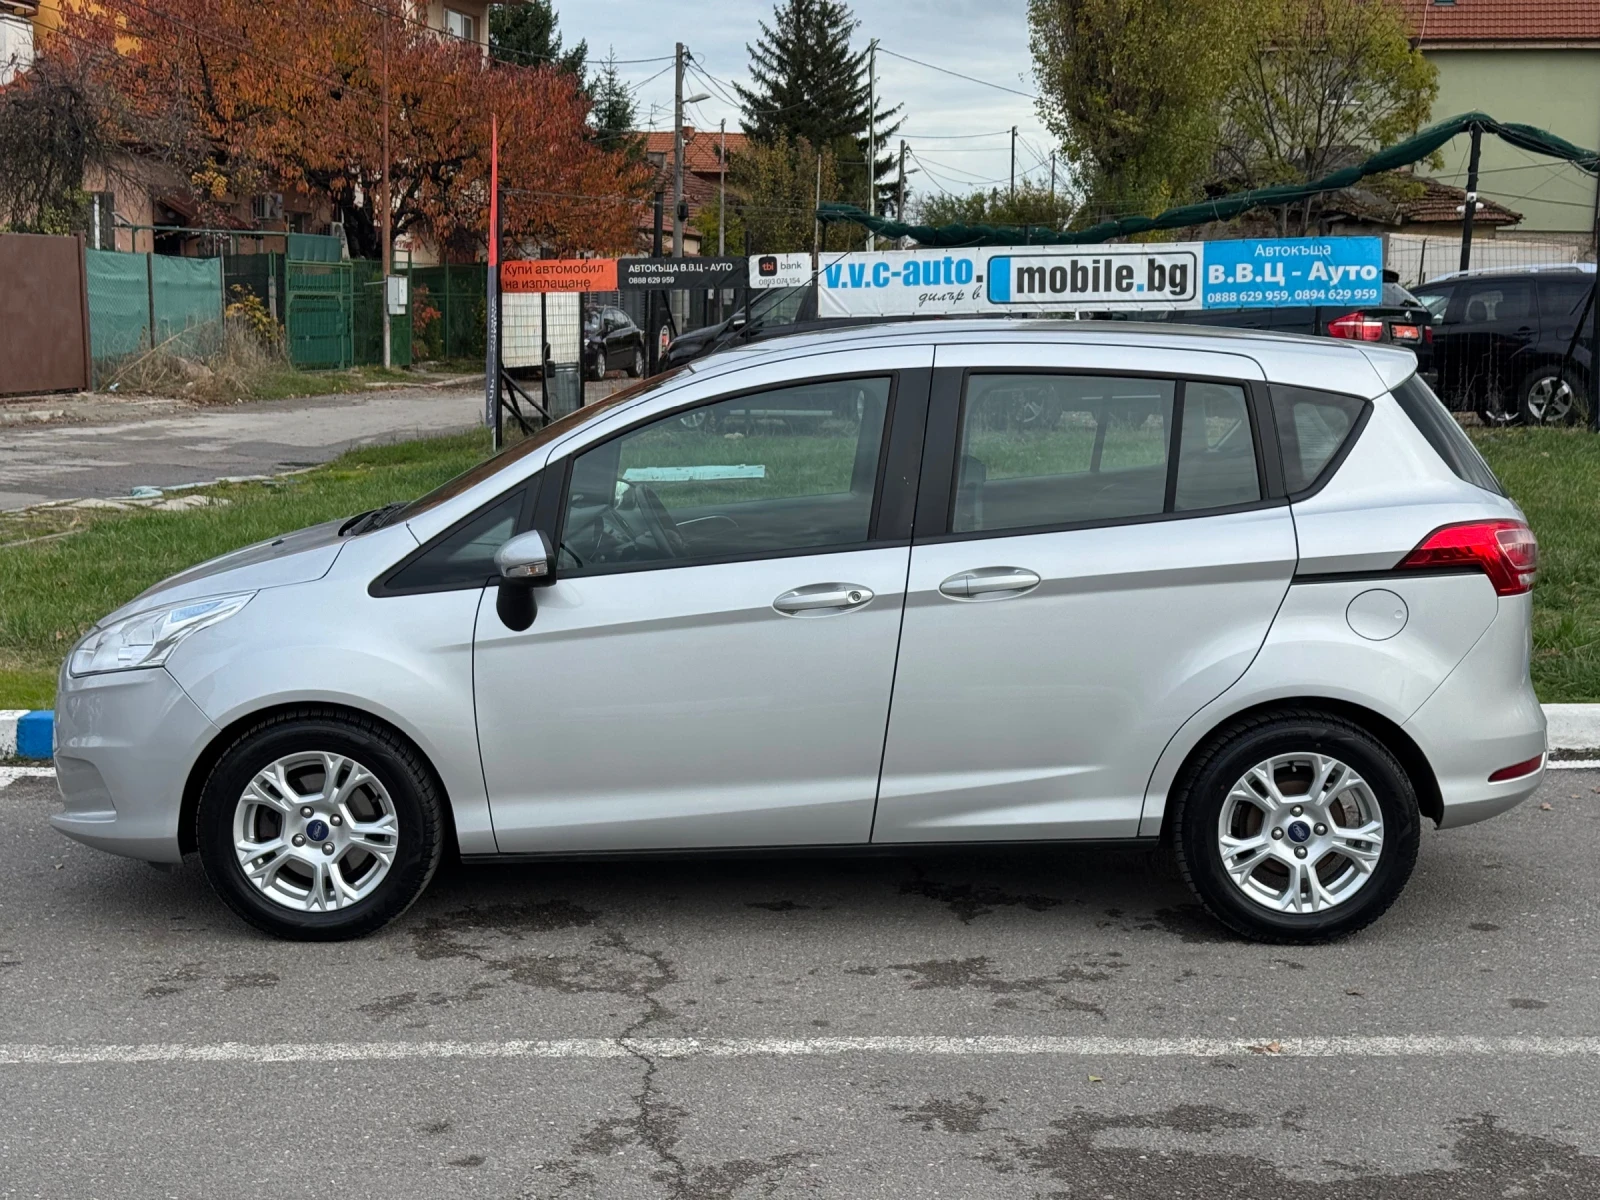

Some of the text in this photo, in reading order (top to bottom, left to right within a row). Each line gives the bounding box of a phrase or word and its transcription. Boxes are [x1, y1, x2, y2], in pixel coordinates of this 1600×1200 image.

[1254, 244, 1331, 258] Автокъща
[504, 263, 604, 277] Купи автомобил
[628, 264, 679, 274] АВТОКЪЩА
[710, 263, 733, 272] АУТО
[762, 261, 802, 271] tbi bank
[628, 276, 675, 284] 0888 629 959
[1016, 258, 1188, 296] mobile.bg
[1308, 261, 1378, 286] Ауто
[505, 279, 591, 290] на изплащане
[758, 278, 775, 286] 0893
[919, 289, 965, 307] дилър
[1207, 288, 1378, 303] 0888 629 959, 0894 629 959
